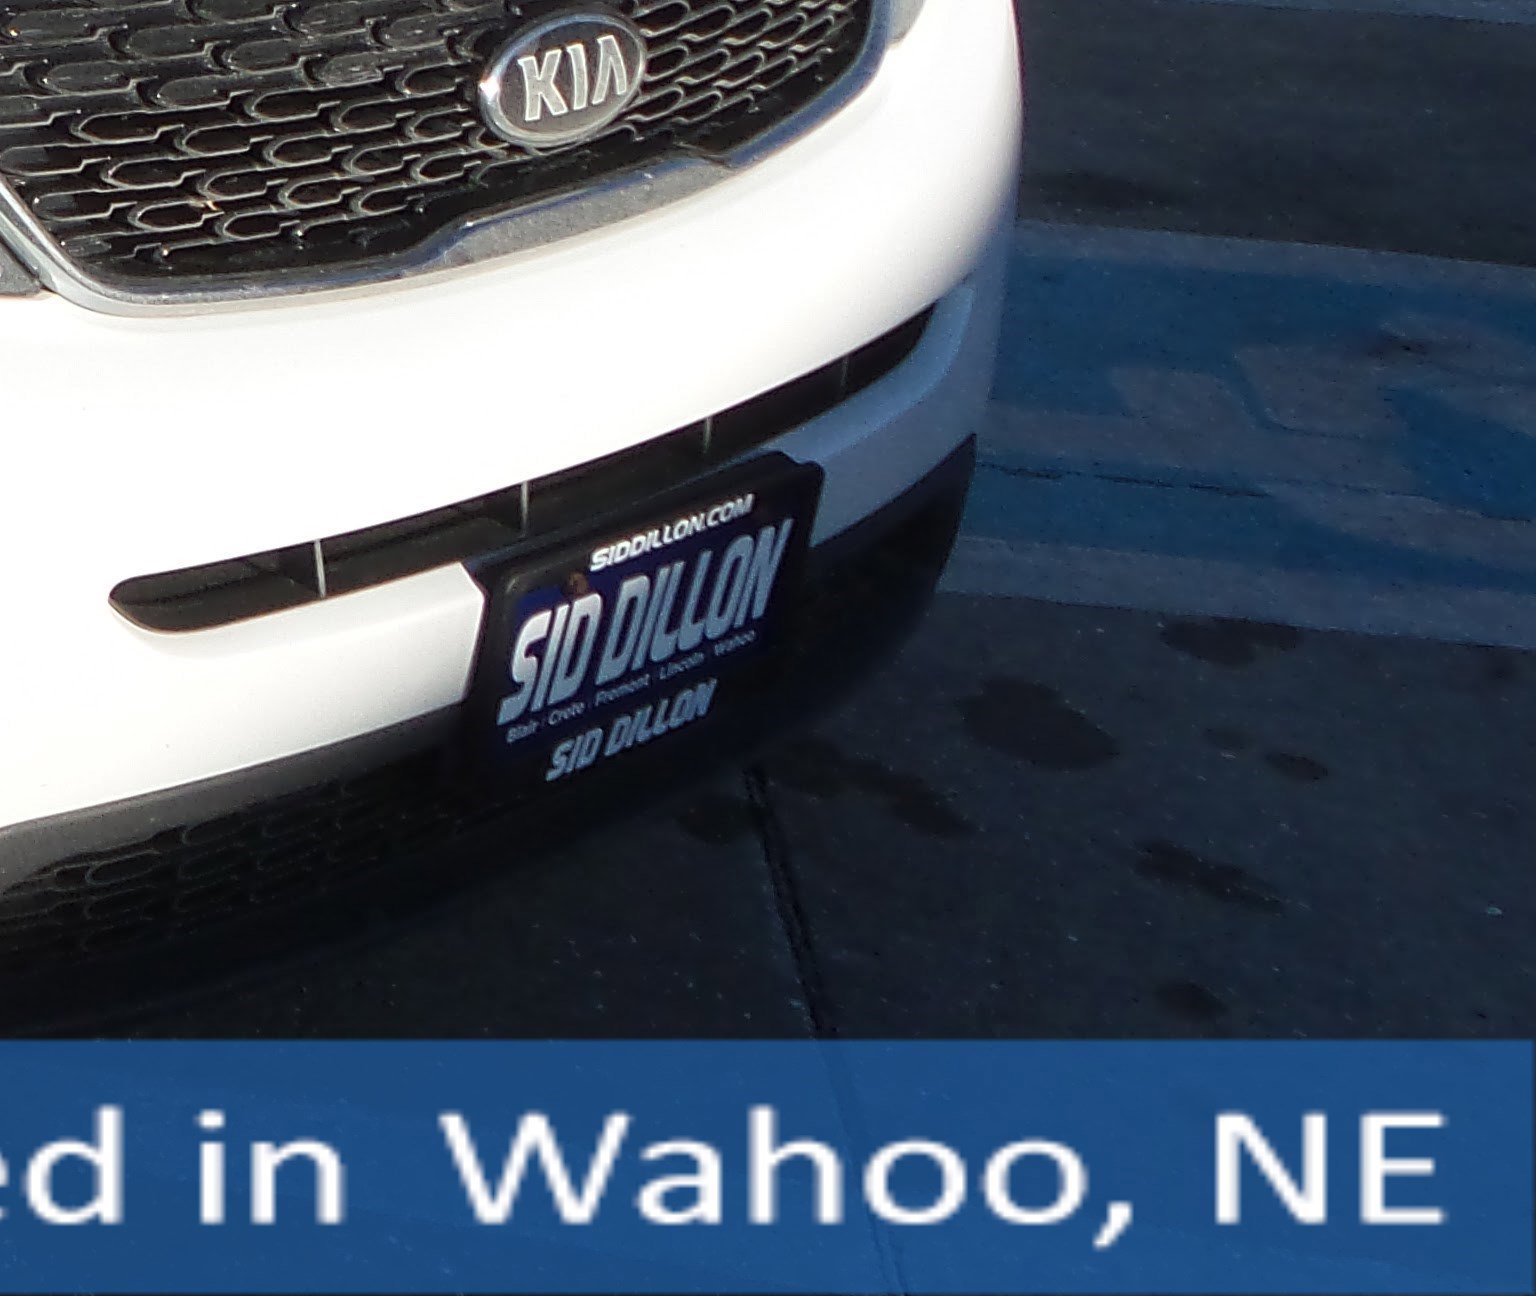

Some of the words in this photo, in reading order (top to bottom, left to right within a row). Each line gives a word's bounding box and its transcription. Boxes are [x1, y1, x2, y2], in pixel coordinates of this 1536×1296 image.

[517, 34, 627, 121] KIA
[589, 493, 756, 571] SIDDILLON.COM
[497, 593, 602, 725] SID
[595, 518, 794, 686] DILLON
[545, 727, 603, 782] SID
[604, 678, 718, 757] DILLON
